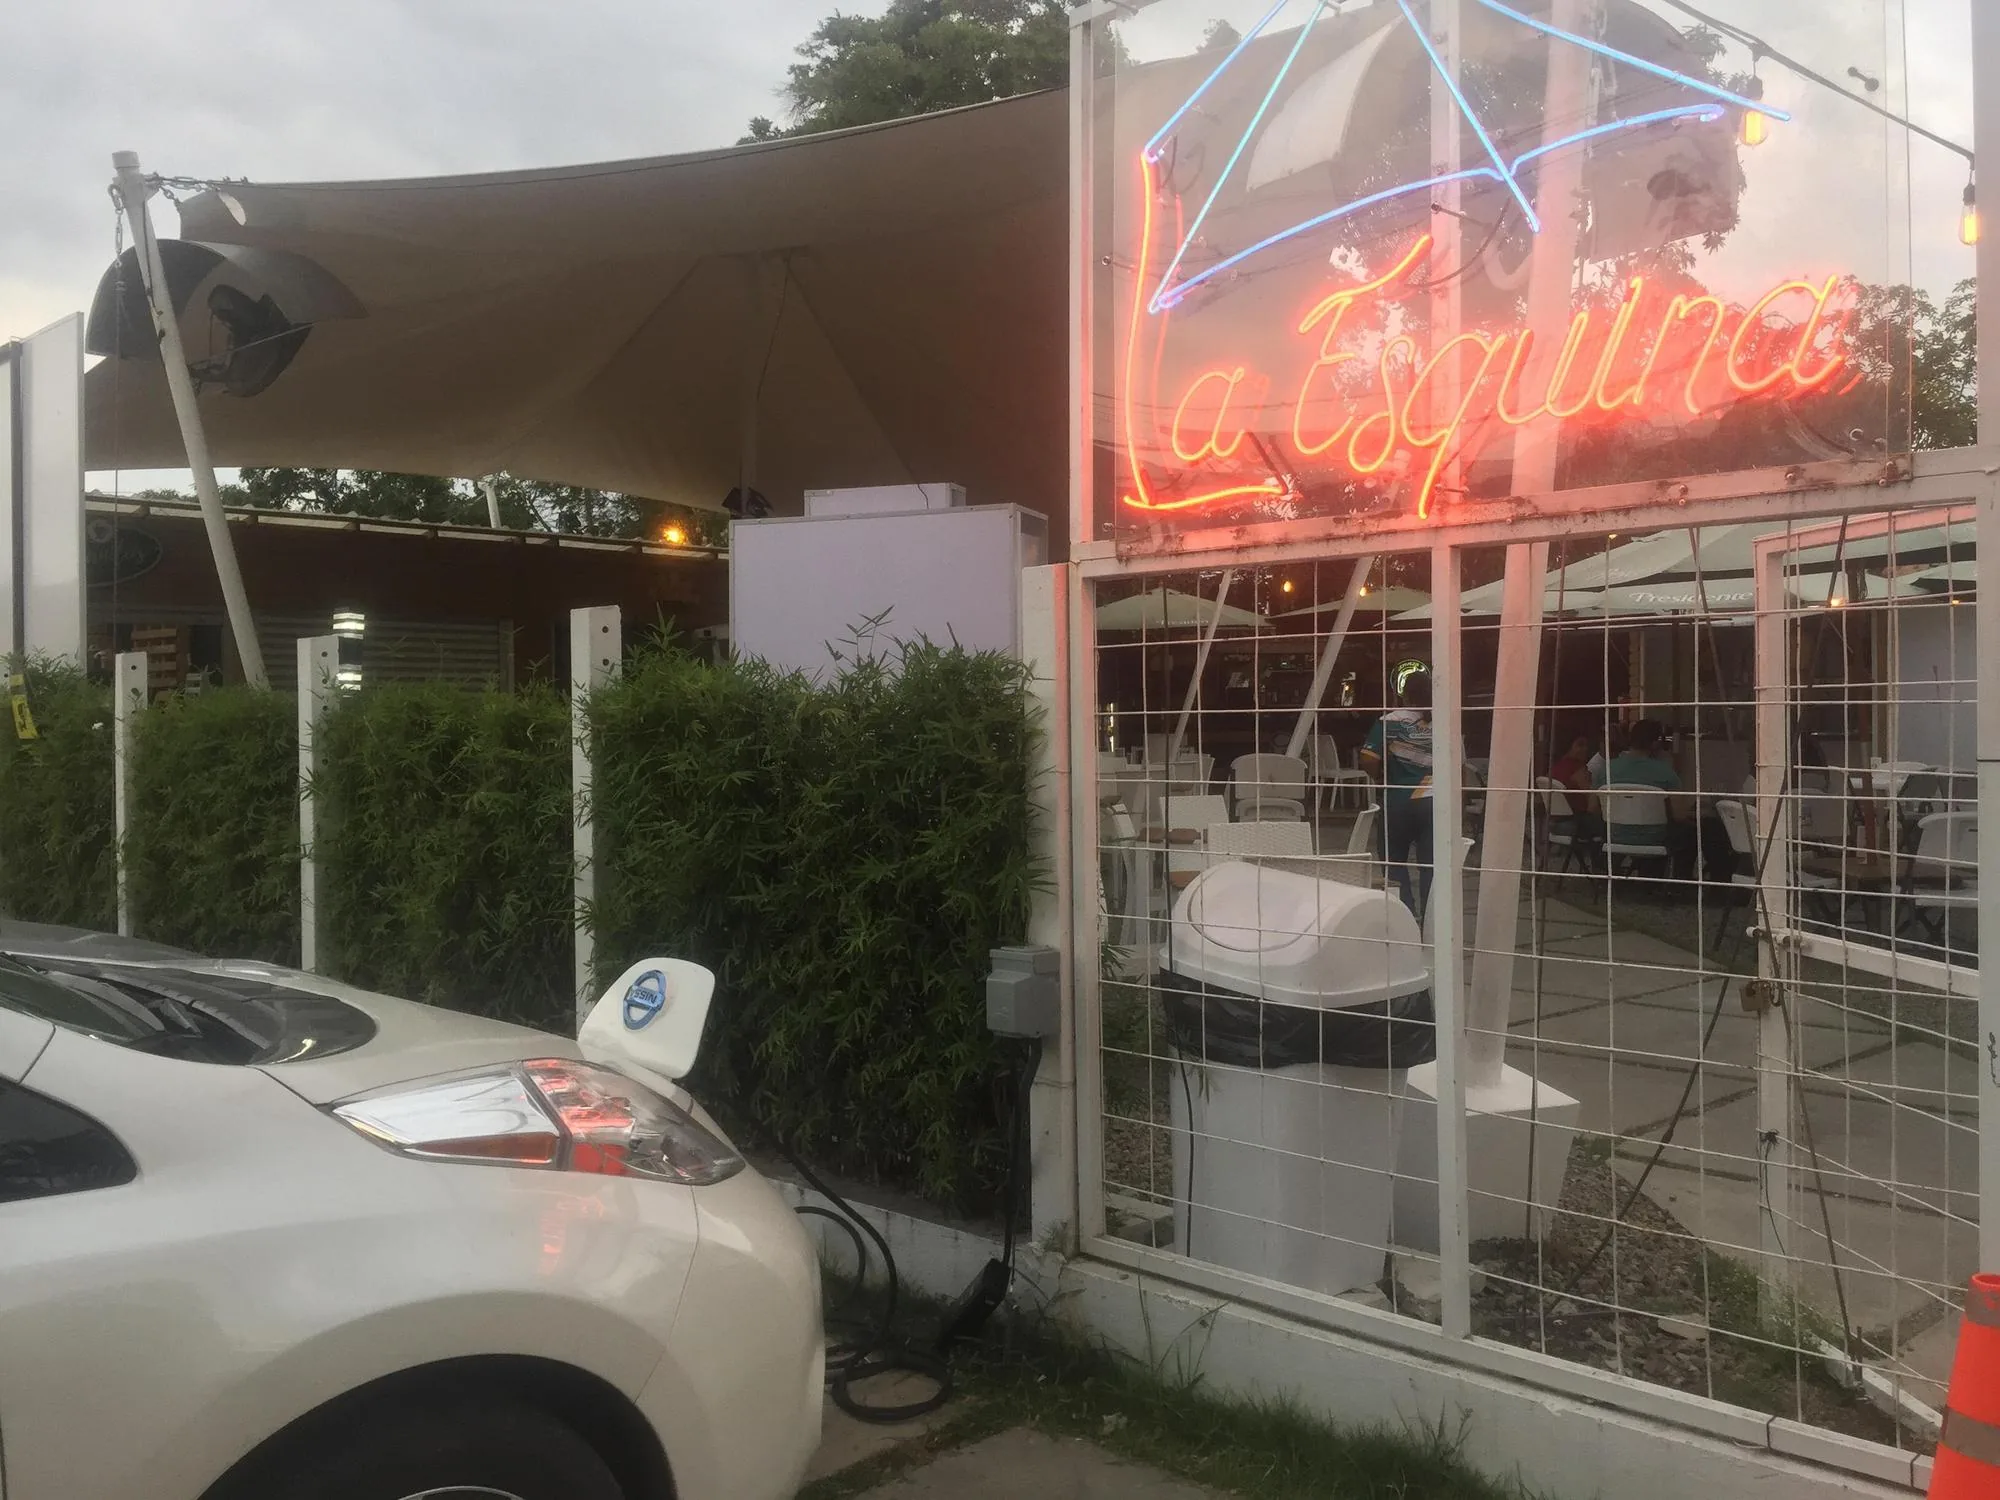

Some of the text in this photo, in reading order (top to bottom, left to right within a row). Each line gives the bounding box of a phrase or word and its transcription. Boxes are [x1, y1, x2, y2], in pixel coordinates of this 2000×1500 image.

[1122, 147, 1847, 520] La Esquina
[629, 987, 659, 1004] NISS
